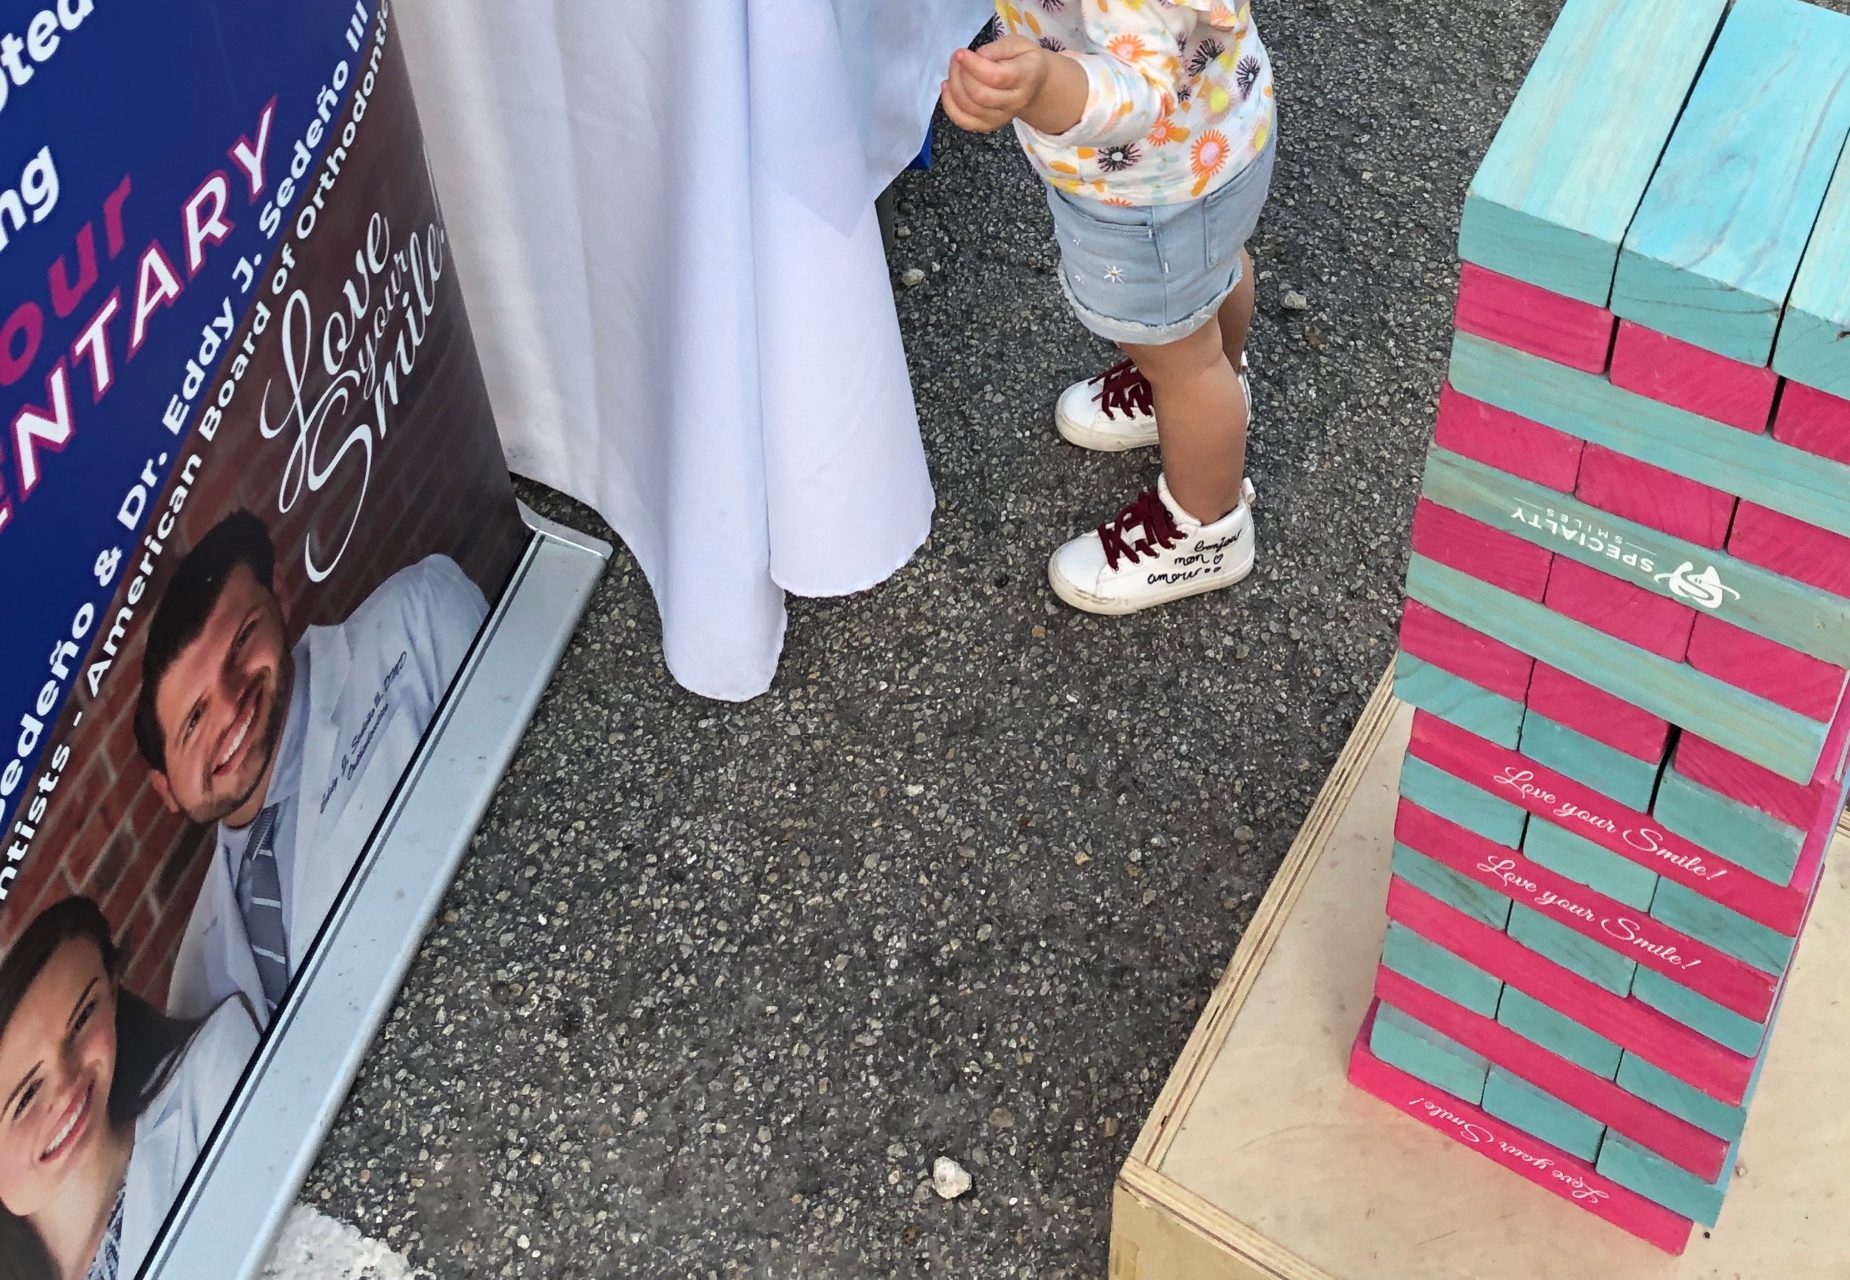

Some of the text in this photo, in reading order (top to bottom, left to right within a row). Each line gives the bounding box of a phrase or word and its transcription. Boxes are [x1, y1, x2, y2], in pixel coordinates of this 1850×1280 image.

[94, 544, 123, 587] &
[117, 452, 168, 531] Dr.
[162, 297, 235, 435] Eddy
[232, 253, 262, 293] J.
[259, 60, 348, 239] Sedeño
[345, 0, 369, 53] III
[357, 249, 409, 400] your
[260, 212, 390, 513] Love
[86, 452, 203, 697] American
[198, 301, 272, 442] Board
[272, 243, 298, 296] of
[1547, 508, 1623, 544] SMILES
[1147, 567, 1202, 584] amour
[1175, 554, 1210, 566] mon
[1510, 506, 1655, 573] SPECIALTY
[1493, 766, 1728, 881] Love your Smile!
[1476, 855, 1702, 970] Love your Smile!
[1408, 1097, 1610, 1204] Love your Smile!
